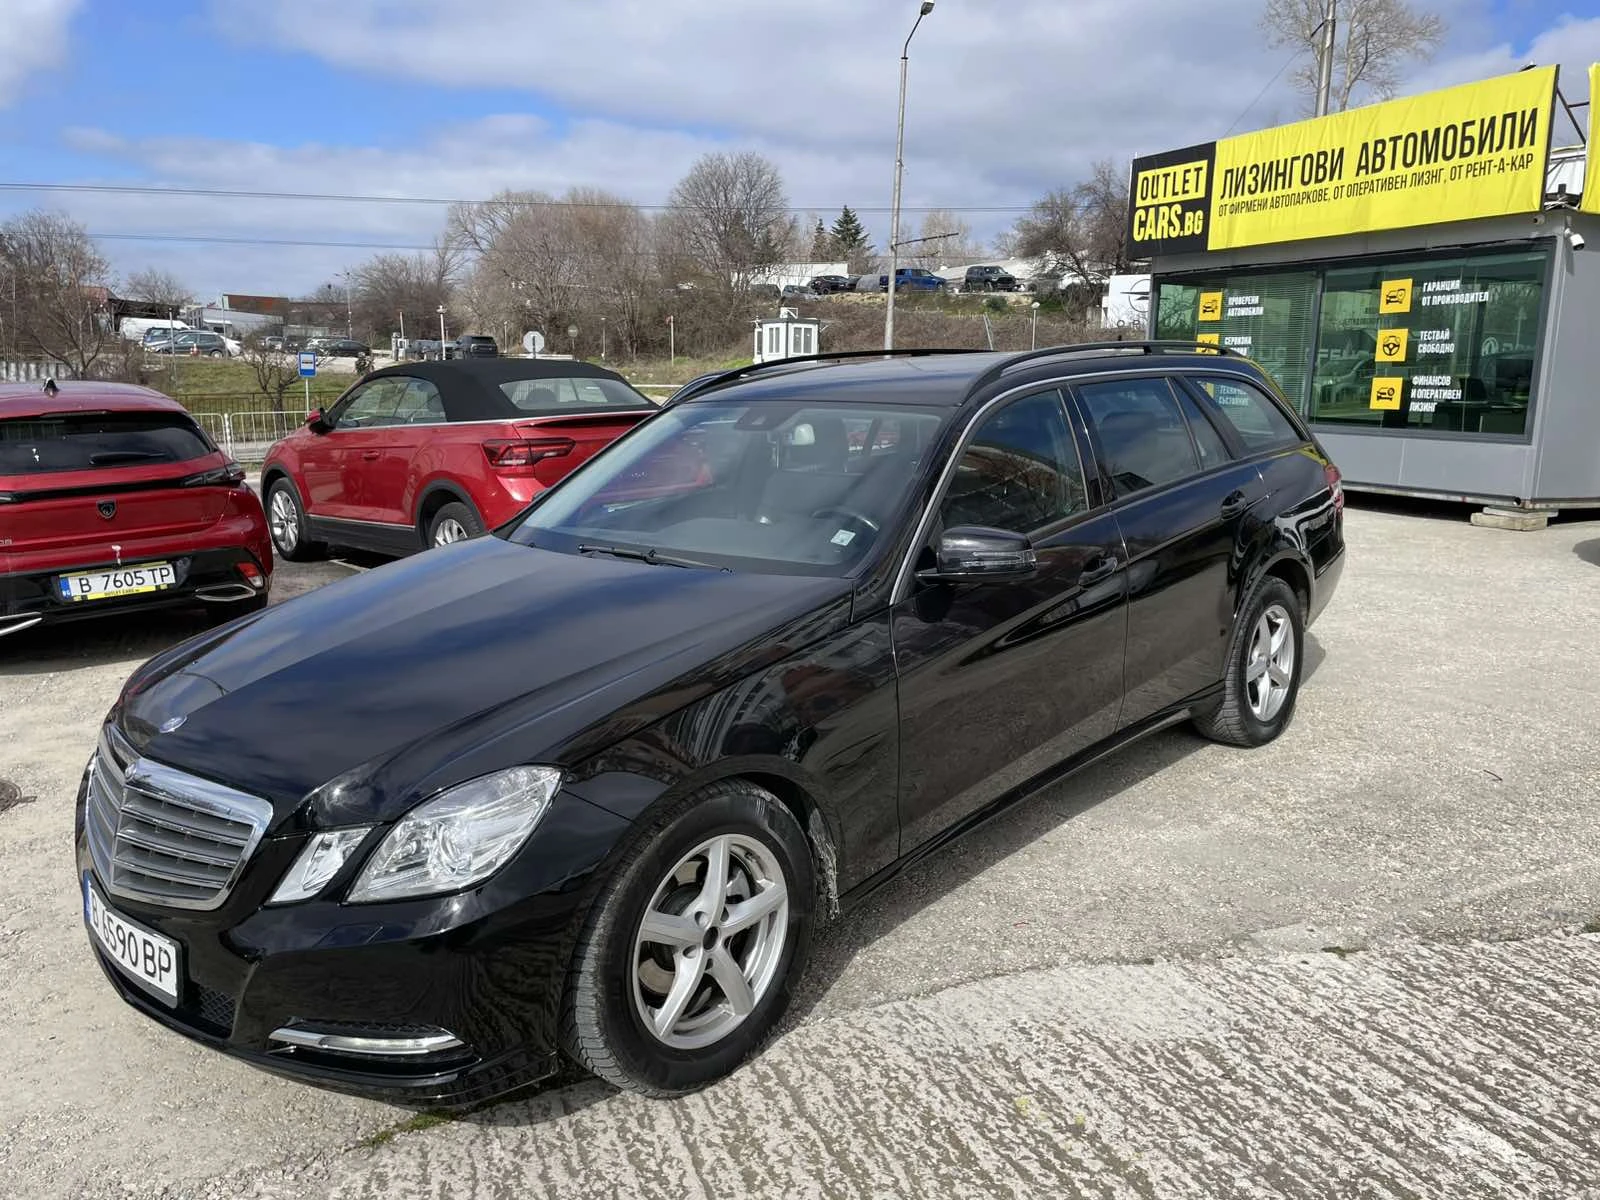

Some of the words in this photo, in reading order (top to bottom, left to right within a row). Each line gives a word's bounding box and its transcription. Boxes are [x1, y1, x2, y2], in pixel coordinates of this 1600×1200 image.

[1220, 147, 1345, 200] ЛИЗИНГОВИ
[1355, 107, 1538, 177] АВТОМОБИЛИ
[1140, 166, 1203, 201] OUTLET
[1218, 203, 1229, 217] ОТ
[1229, 199, 1268, 215] ФИРМЕНИ
[1333, 184, 1345, 200] ОТ
[1346, 174, 1408, 198] ОПЕРАТИВЕН
[1450, 164, 1463, 182] ОТ
[1465, 152, 1534, 178] РЕНТ-А-КАР
[1133, 203, 1204, 242] CARS.BG
[1423, 280, 1461, 292] ГАРАНЦИЯ
[1422, 296, 1431, 306] ОТ
[1431, 291, 1489, 306] ПРОИЗВОДИТЕЛ
[1420, 328, 1450, 341] ТЕСТВАЙ
[1417, 343, 1455, 354] СВОБОДНО
[1412, 375, 1451, 386] ФИНАНСОВ
[1410, 388, 1417, 399] И
[1416, 388, 1462, 400] ОПЕРАТИВЕН
[1409, 401, 1438, 412] ЛИЗИНГ
[79, 577, 92, 593] B
[102, 570, 145, 591] 7605
[147, 567, 171, 584] TP
[102, 906, 139, 968] 6590
[142, 937, 172, 983] BP
